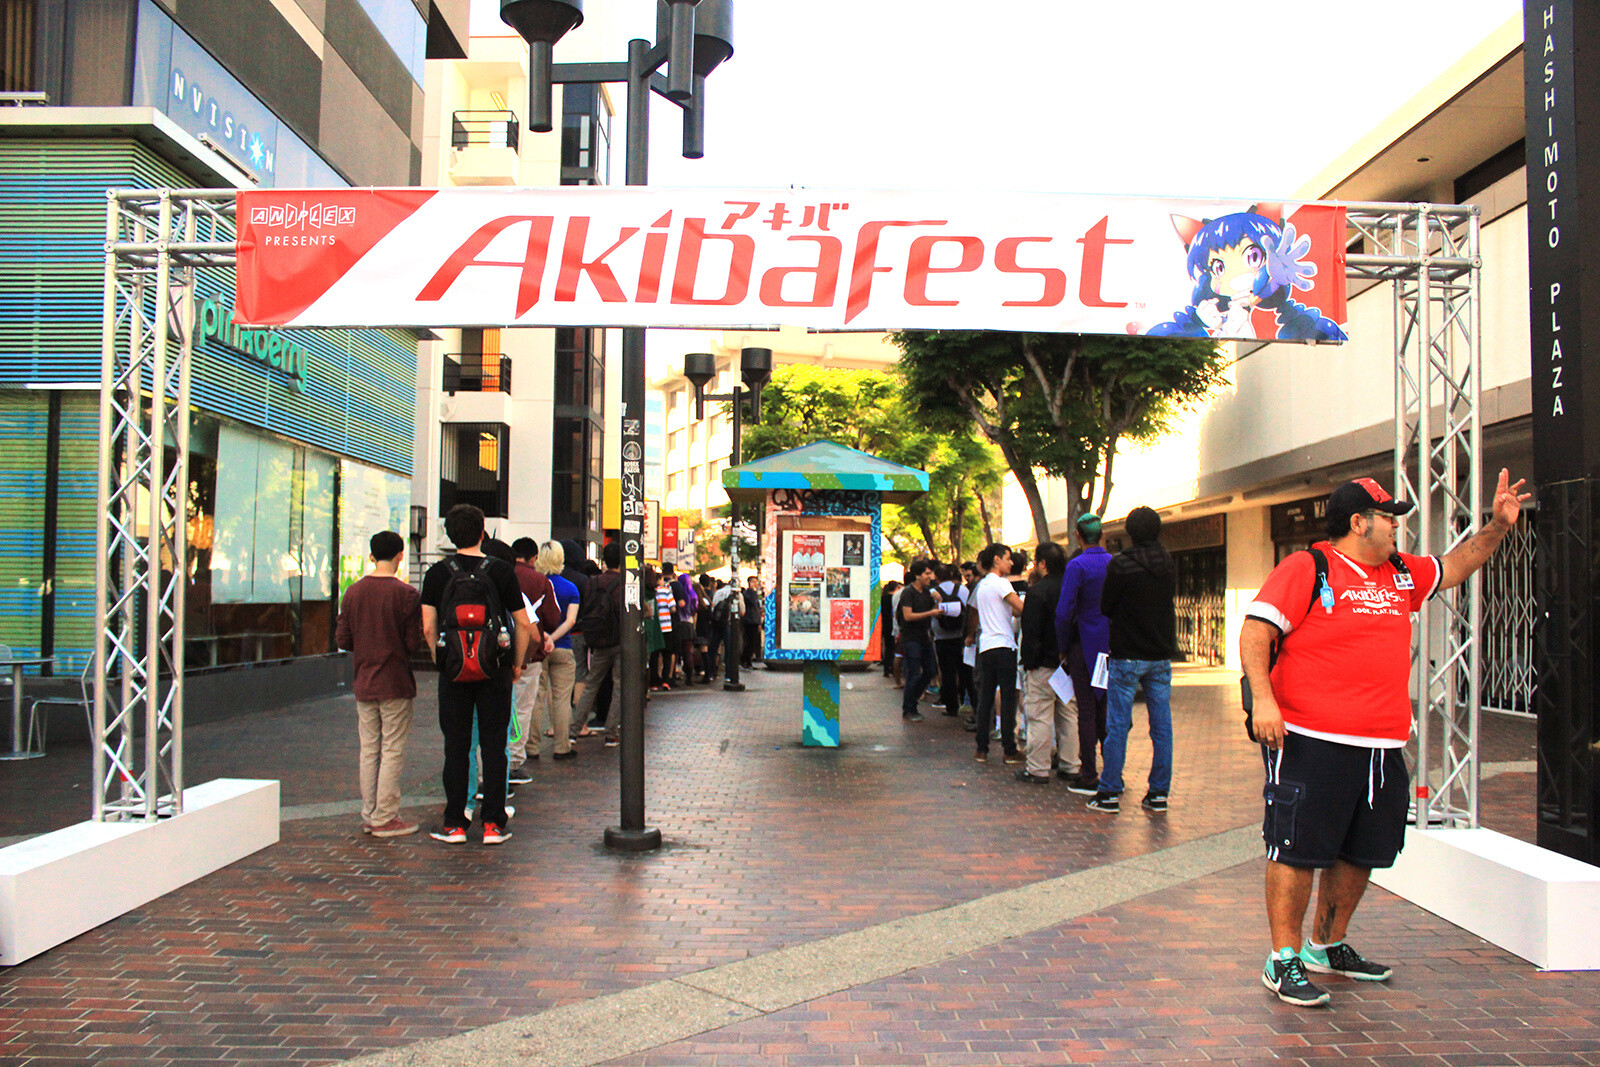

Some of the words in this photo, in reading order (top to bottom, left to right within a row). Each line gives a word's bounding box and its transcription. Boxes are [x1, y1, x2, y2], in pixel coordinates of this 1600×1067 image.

[1542, 4, 1560, 249] HASHIMOTO
[251, 202, 356, 230] ANIPLEX
[721, 200, 849, 231] アキバ
[265, 235, 336, 246] PRESENTS
[1549, 282, 1564, 418] PLAZA
